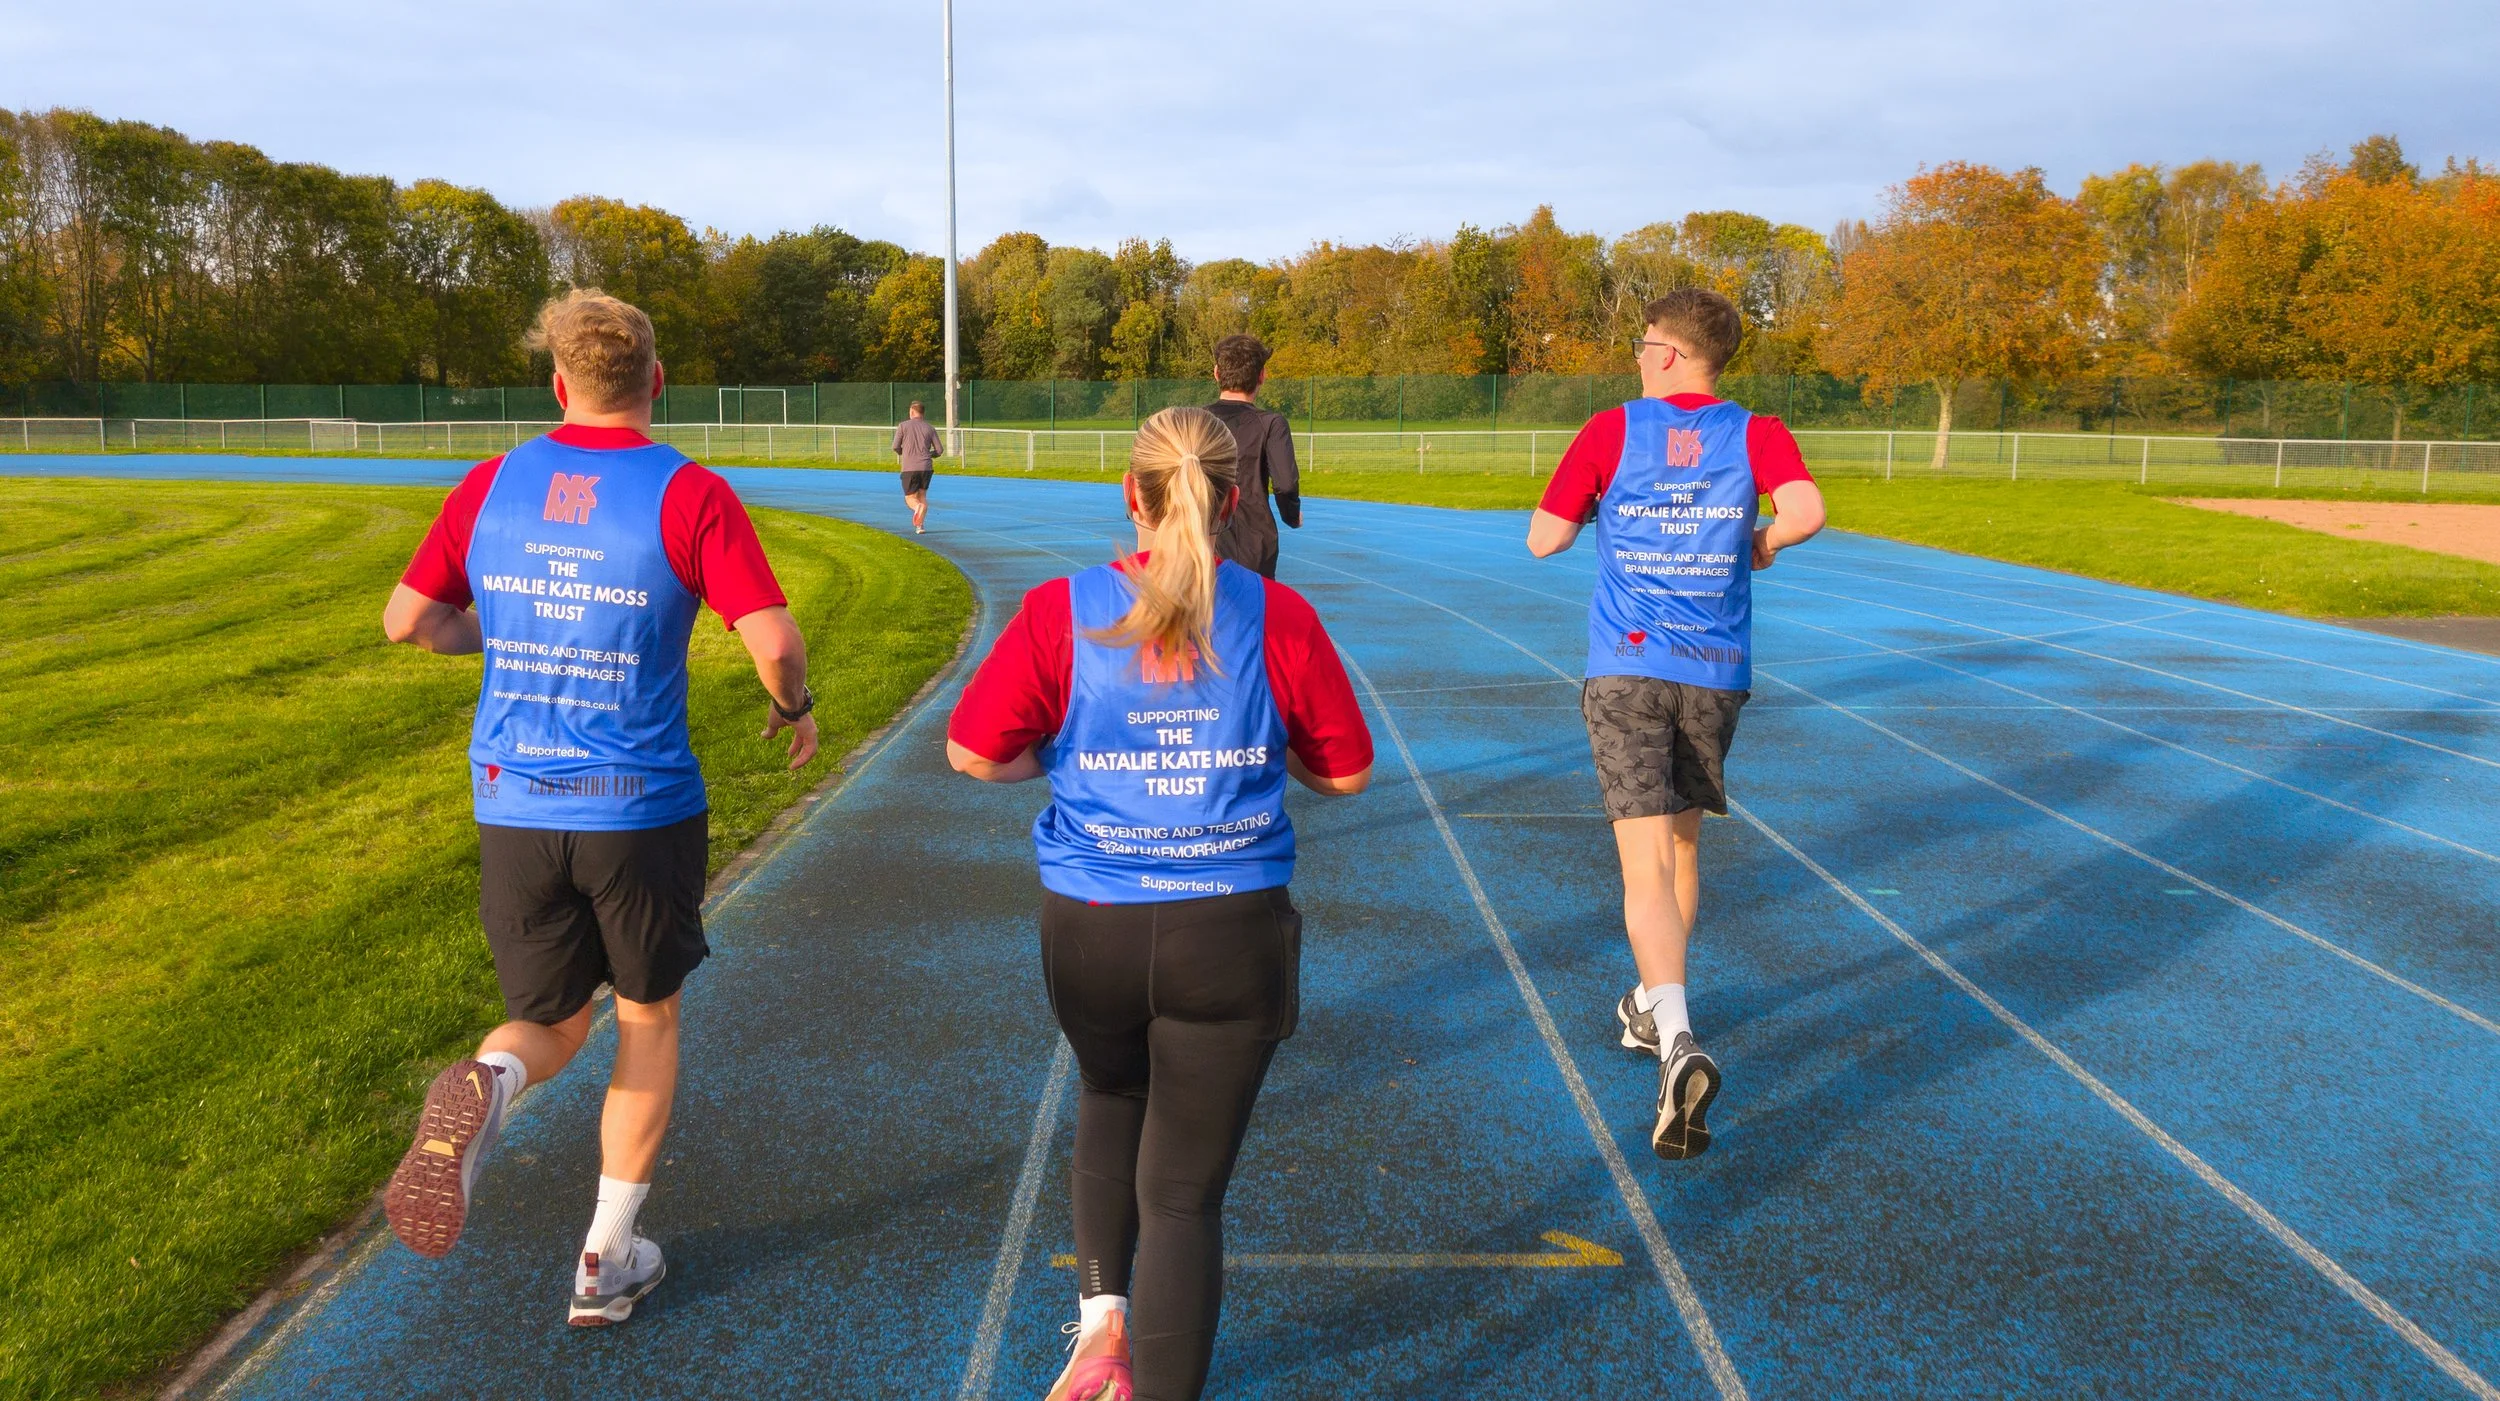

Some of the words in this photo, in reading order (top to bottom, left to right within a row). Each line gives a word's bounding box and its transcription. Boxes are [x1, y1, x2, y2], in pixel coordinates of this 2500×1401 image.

[1653, 480, 1711, 491] SUPPORTING
[1671, 493, 1693, 504] THE
[1618, 505, 1669, 519] NATALIE
[1671, 507, 1703, 519] KATE
[1705, 507, 1744, 519] MOSS
[1660, 522, 1699, 535] TRUST
[525, 542, 604, 561] SUPPORTING
[1616, 550, 1672, 563] PREVENTING
[1673, 553, 1695, 563] AND
[1696, 553, 1738, 564] TREATING
[548, 560, 578, 578] THE
[1625, 563, 1651, 575] BRAIN
[1652, 565, 1729, 577] HAEMORRHAGES
[482, 575, 546, 596] NATALIE
[549, 581, 592, 601] KATE
[594, 586, 648, 607] MOSS
[534, 601, 585, 622] TRUST
[1697, 624, 1708, 633] by
[550, 646, 577, 659] AND
[579, 649, 640, 665] TREATING
[1614, 645, 1645, 658] MCR
[525, 660, 625, 682] HAEMORRHAGES
[1127, 708, 1220, 725] SUPPORTING
[1156, 728, 1193, 746] THE
[516, 742, 574, 758] Supported
[576, 747, 590, 759] by
[1079, 751, 1157, 771] NATALIE
[1161, 752, 1212, 770] KATE
[1215, 746, 1267, 769] MOSS
[614, 775, 647, 797] LIFE
[1145, 776, 1207, 796] TRUST
[1084, 823, 1169, 839] PREVENTING
[1172, 825, 1204, 838] AND
[1206, 812, 1271, 835] TREATING
[1141, 875, 1214, 893] Supported
[1217, 881, 1233, 895] by
